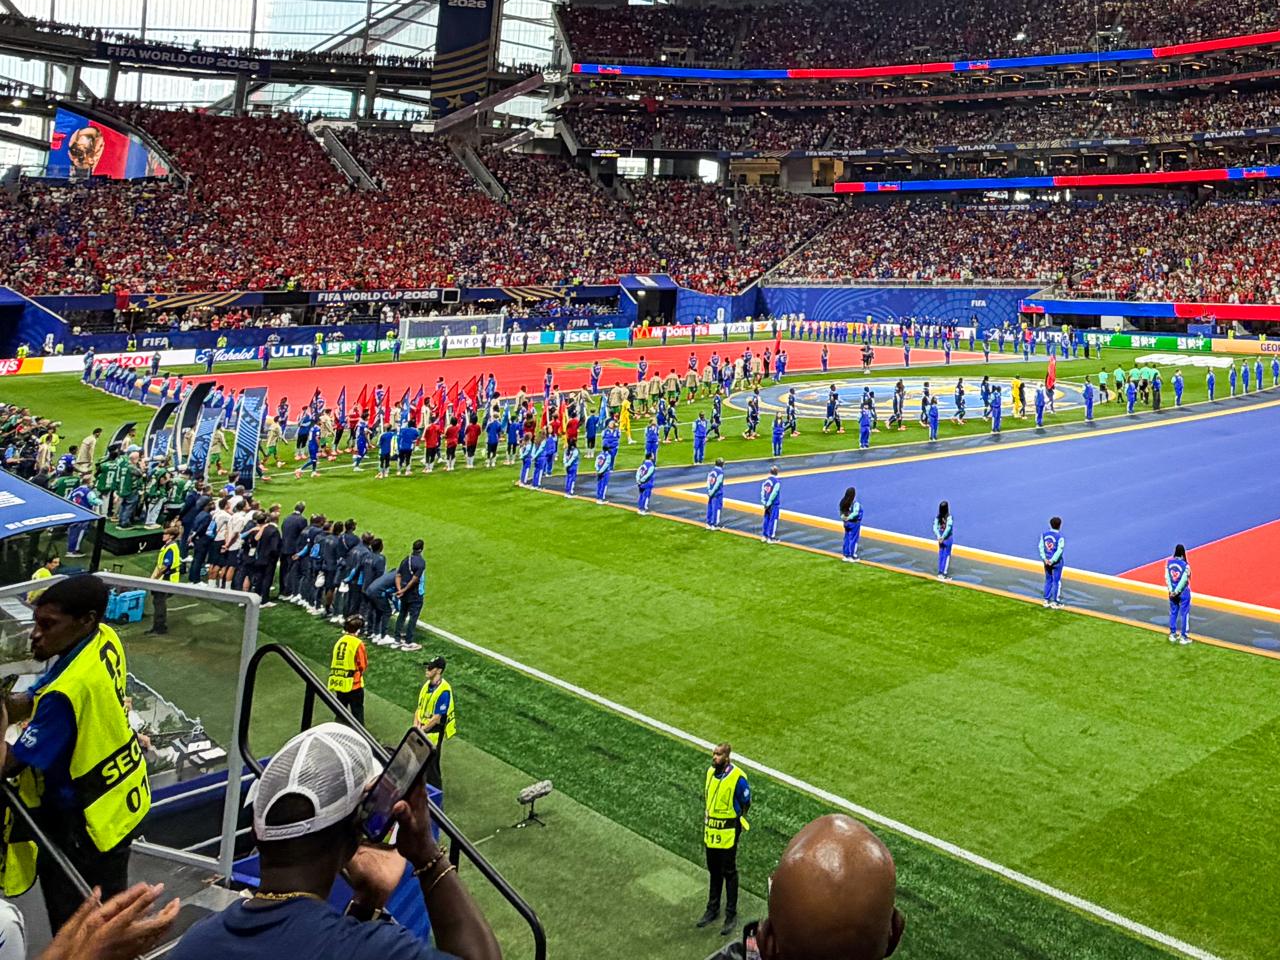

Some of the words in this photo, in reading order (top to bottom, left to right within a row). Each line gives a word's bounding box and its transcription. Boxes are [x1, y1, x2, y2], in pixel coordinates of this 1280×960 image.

[107, 46, 136, 58] FIFA
[139, 50, 187, 62] WORLD
[189, 55, 215, 65] CUP
[216, 58, 260, 70] 2026
[1203, 130, 1245, 139] ATLANTA
[957, 143, 996, 151] ATLANTA
[317, 293, 341, 301] FIFA
[343, 292, 381, 301] WORLD
[382, 291, 402, 300] CUP
[403, 290, 438, 299] 2026
[651, 324, 709, 337] McDonad's
[143, 337, 168, 349] FIFA
